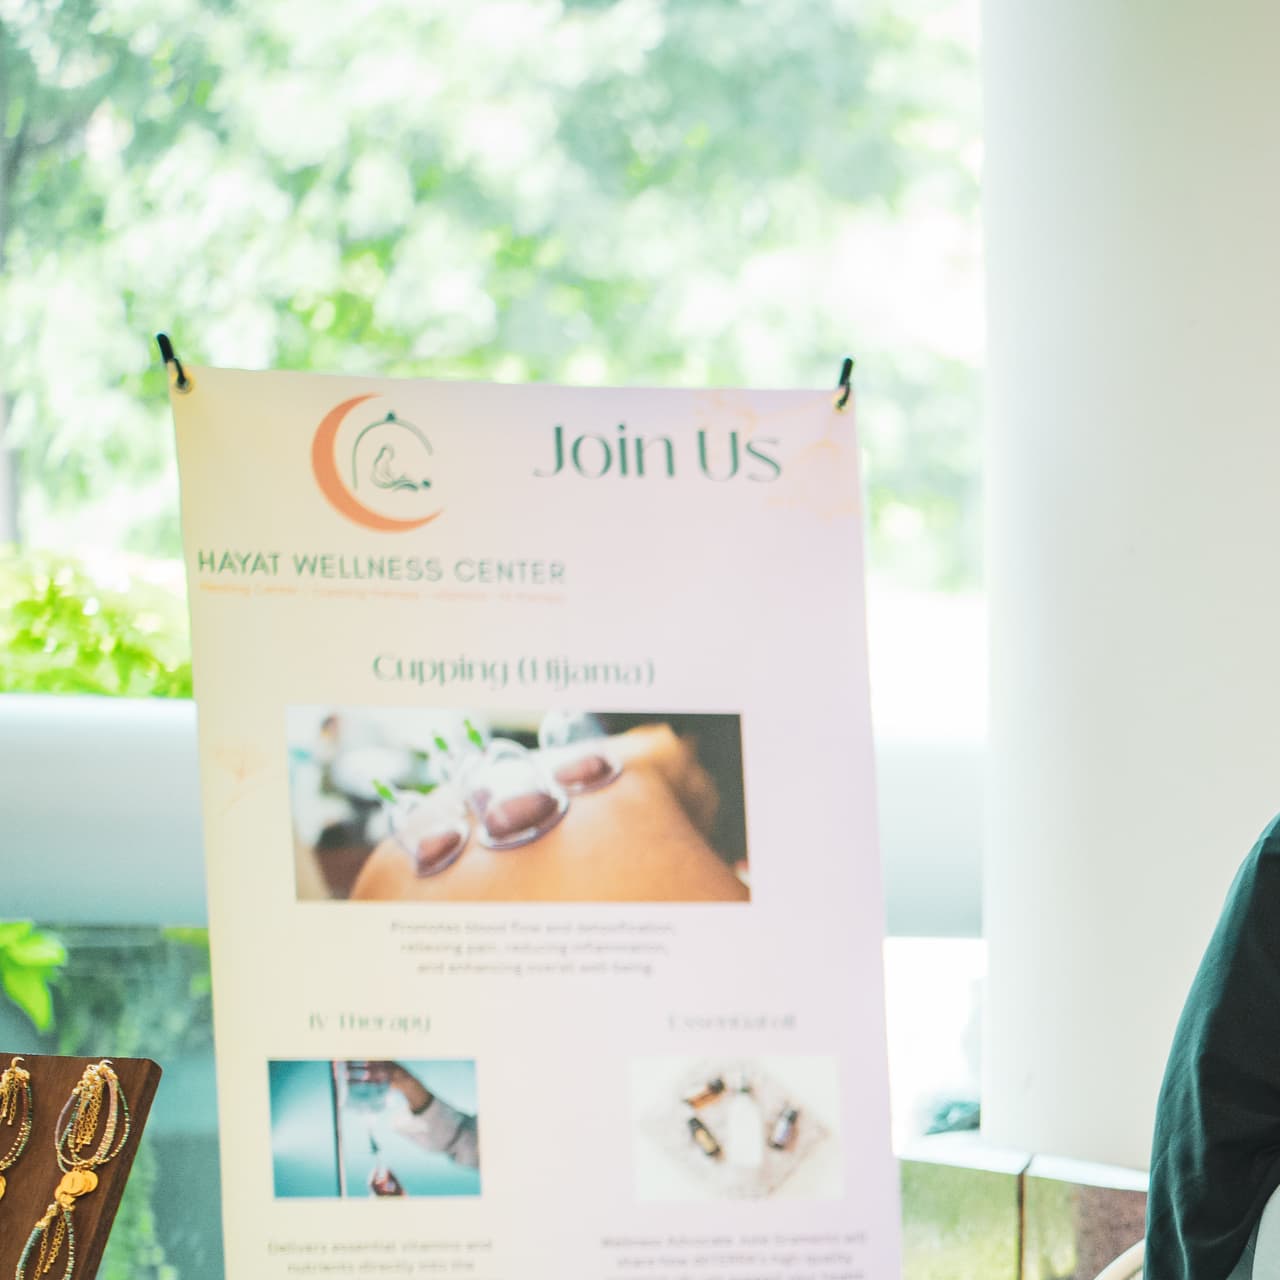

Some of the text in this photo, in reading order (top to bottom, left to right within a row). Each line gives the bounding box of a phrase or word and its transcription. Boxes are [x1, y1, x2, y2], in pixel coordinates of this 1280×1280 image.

[533, 423, 784, 483] Join Us
[198, 550, 567, 586] HAYAT WELLNESS CENTER
[372, 652, 509, 691] Cupping
[338, 1010, 433, 1037] Therapy
